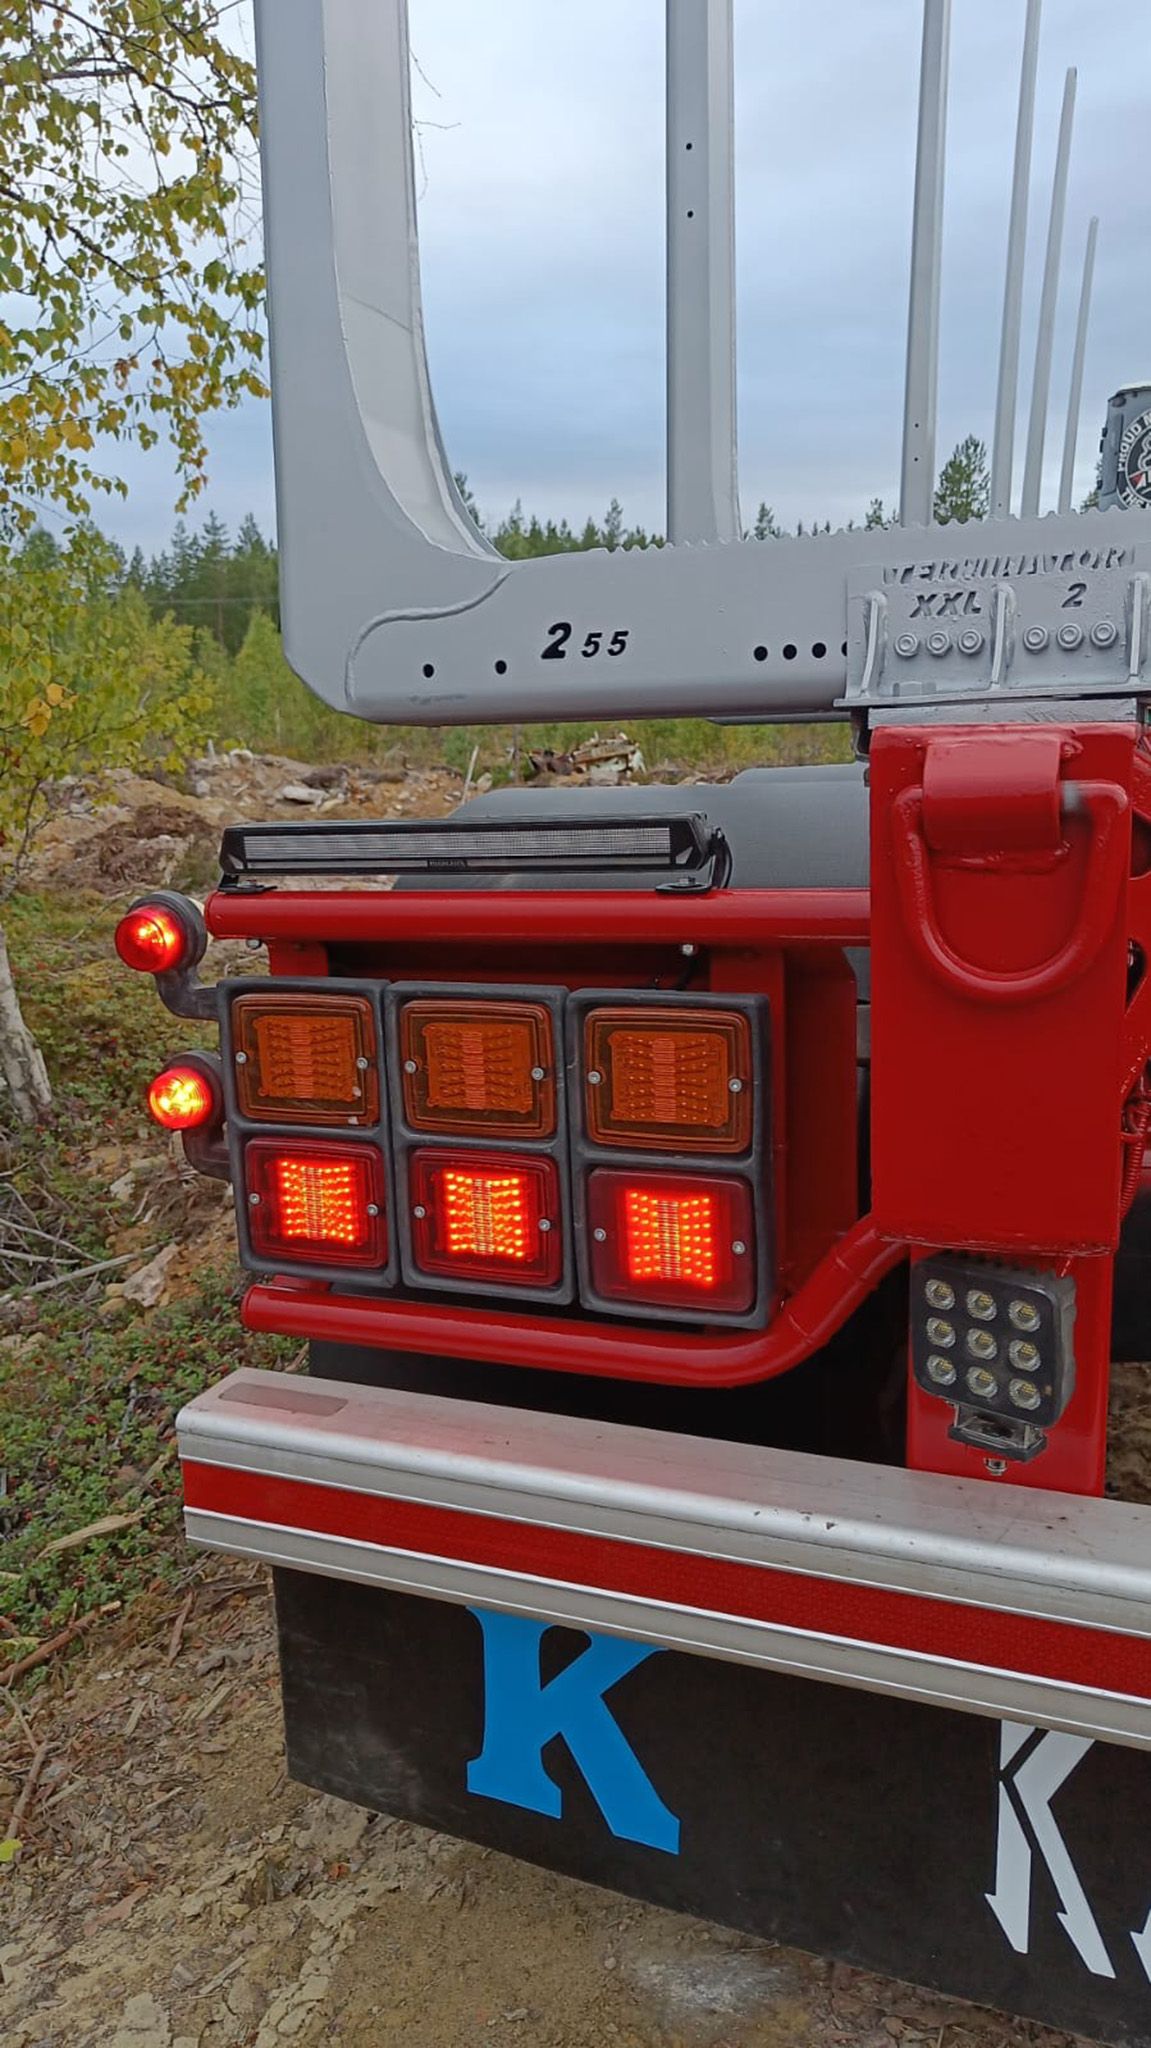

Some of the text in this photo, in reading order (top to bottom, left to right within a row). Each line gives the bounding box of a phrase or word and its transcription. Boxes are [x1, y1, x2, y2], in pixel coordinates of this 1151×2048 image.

[1117, 423, 1142, 472] PROUD
[882, 548, 1134, 584] TERMINATOR
[909, 583, 1087, 618] XXL 2
[465, 1604, 680, 1855] K
